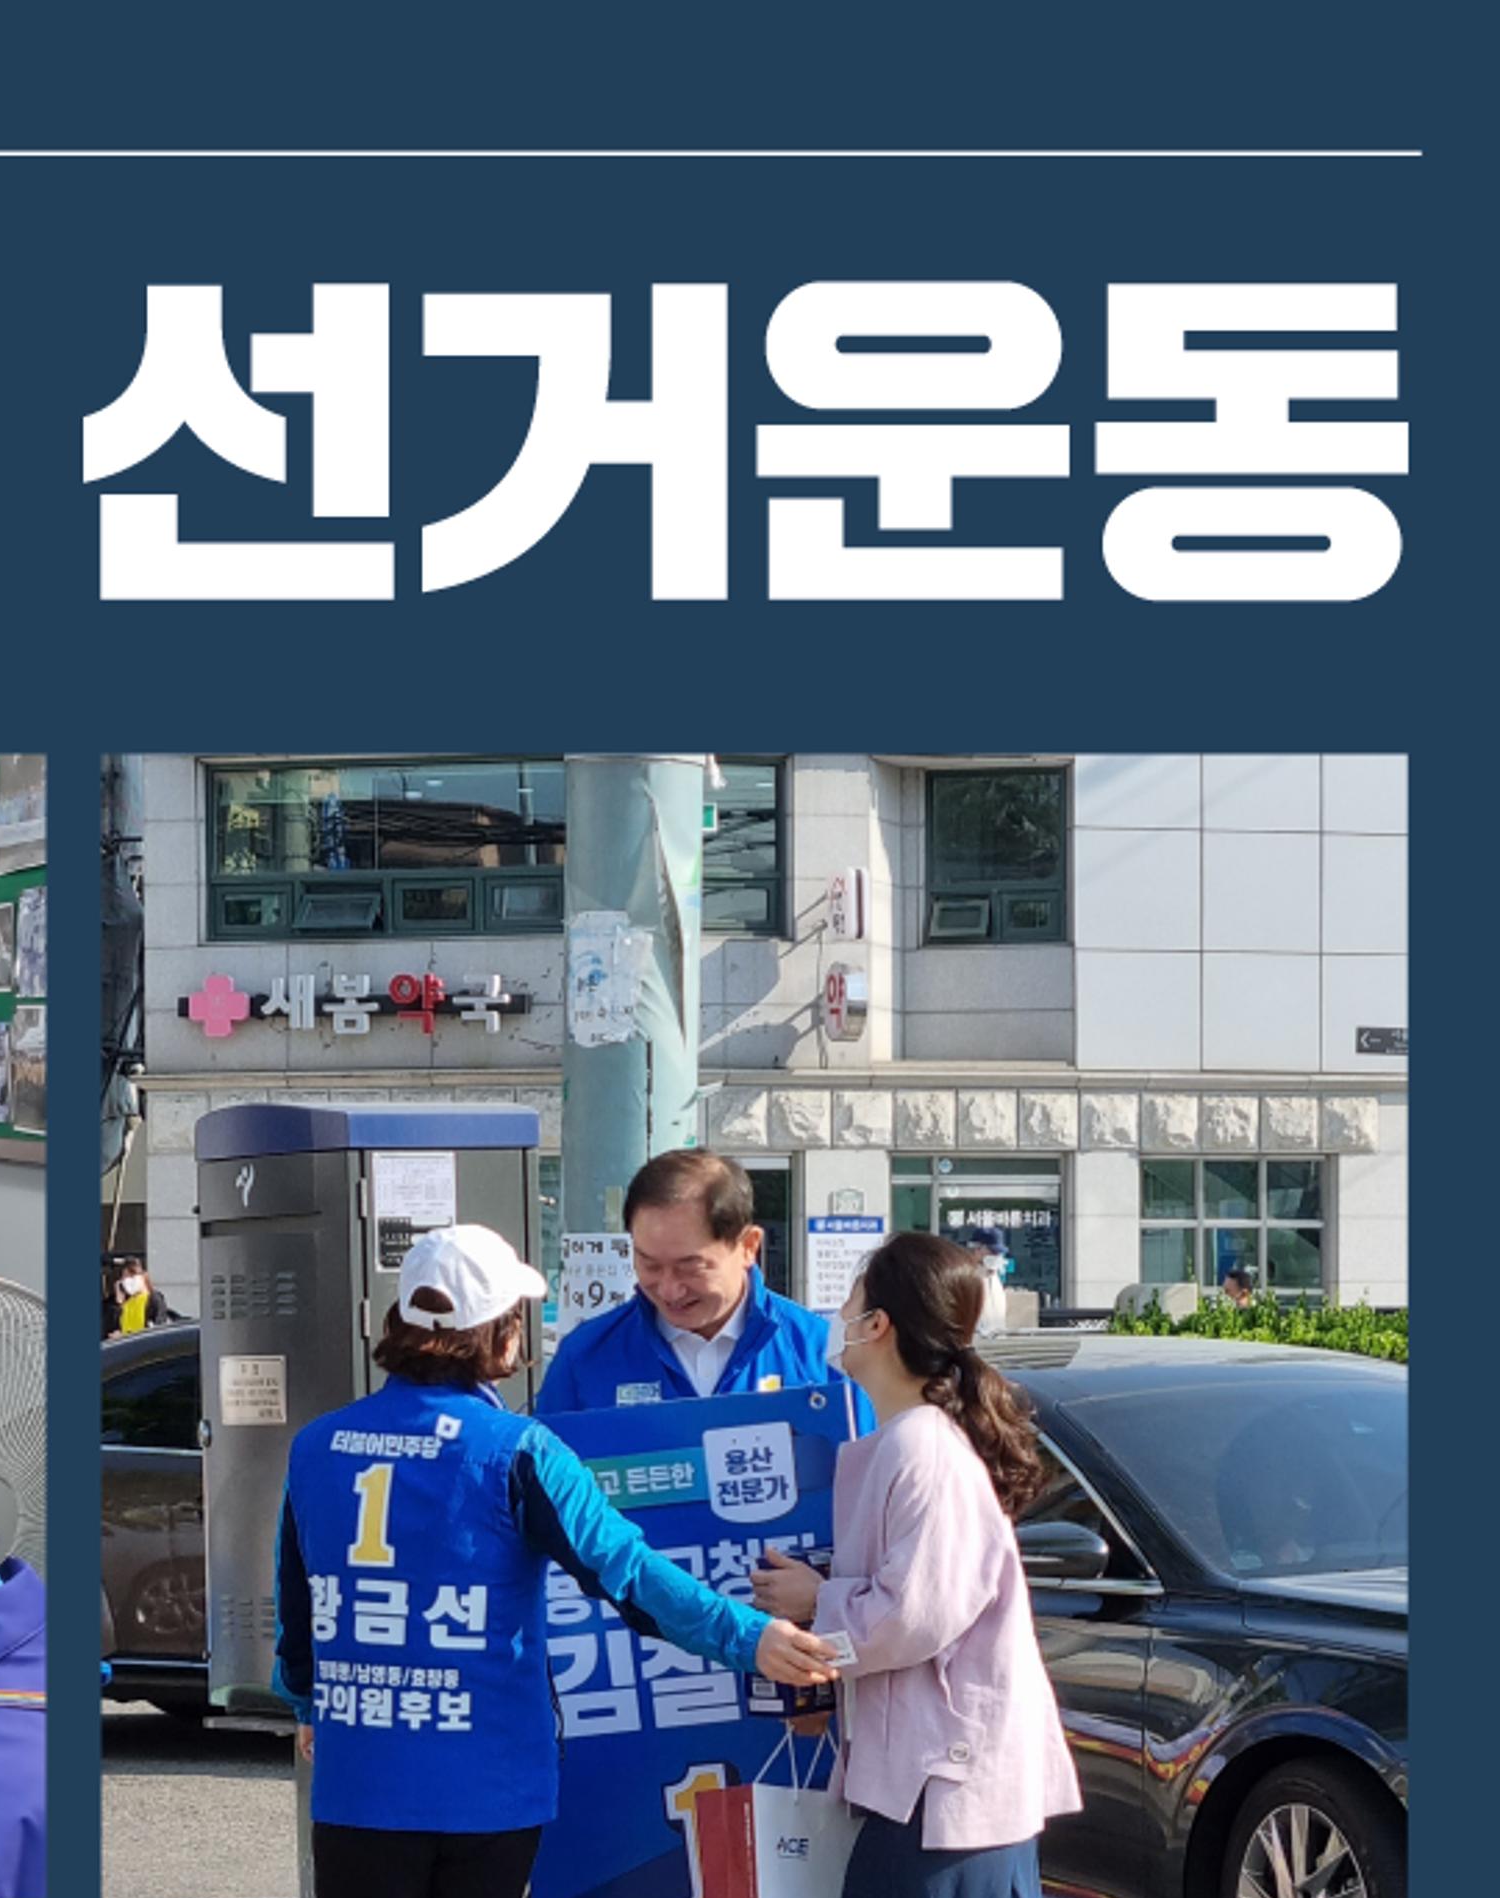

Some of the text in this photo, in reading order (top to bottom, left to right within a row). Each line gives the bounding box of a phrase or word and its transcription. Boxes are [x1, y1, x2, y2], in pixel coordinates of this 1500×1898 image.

[261, 973, 510, 1035] 새봄약국
[330, 1429, 443, 1459] 더불어민주당
[725, 1448, 774, 1476] 용산
[627, 1462, 695, 1495] 든든한
[716, 1477, 790, 1506] 전문가
[347, 1463, 395, 1568] 1
[308, 1574, 488, 1650] 황금선
[314, 1683, 472, 1731] 구의원후보
